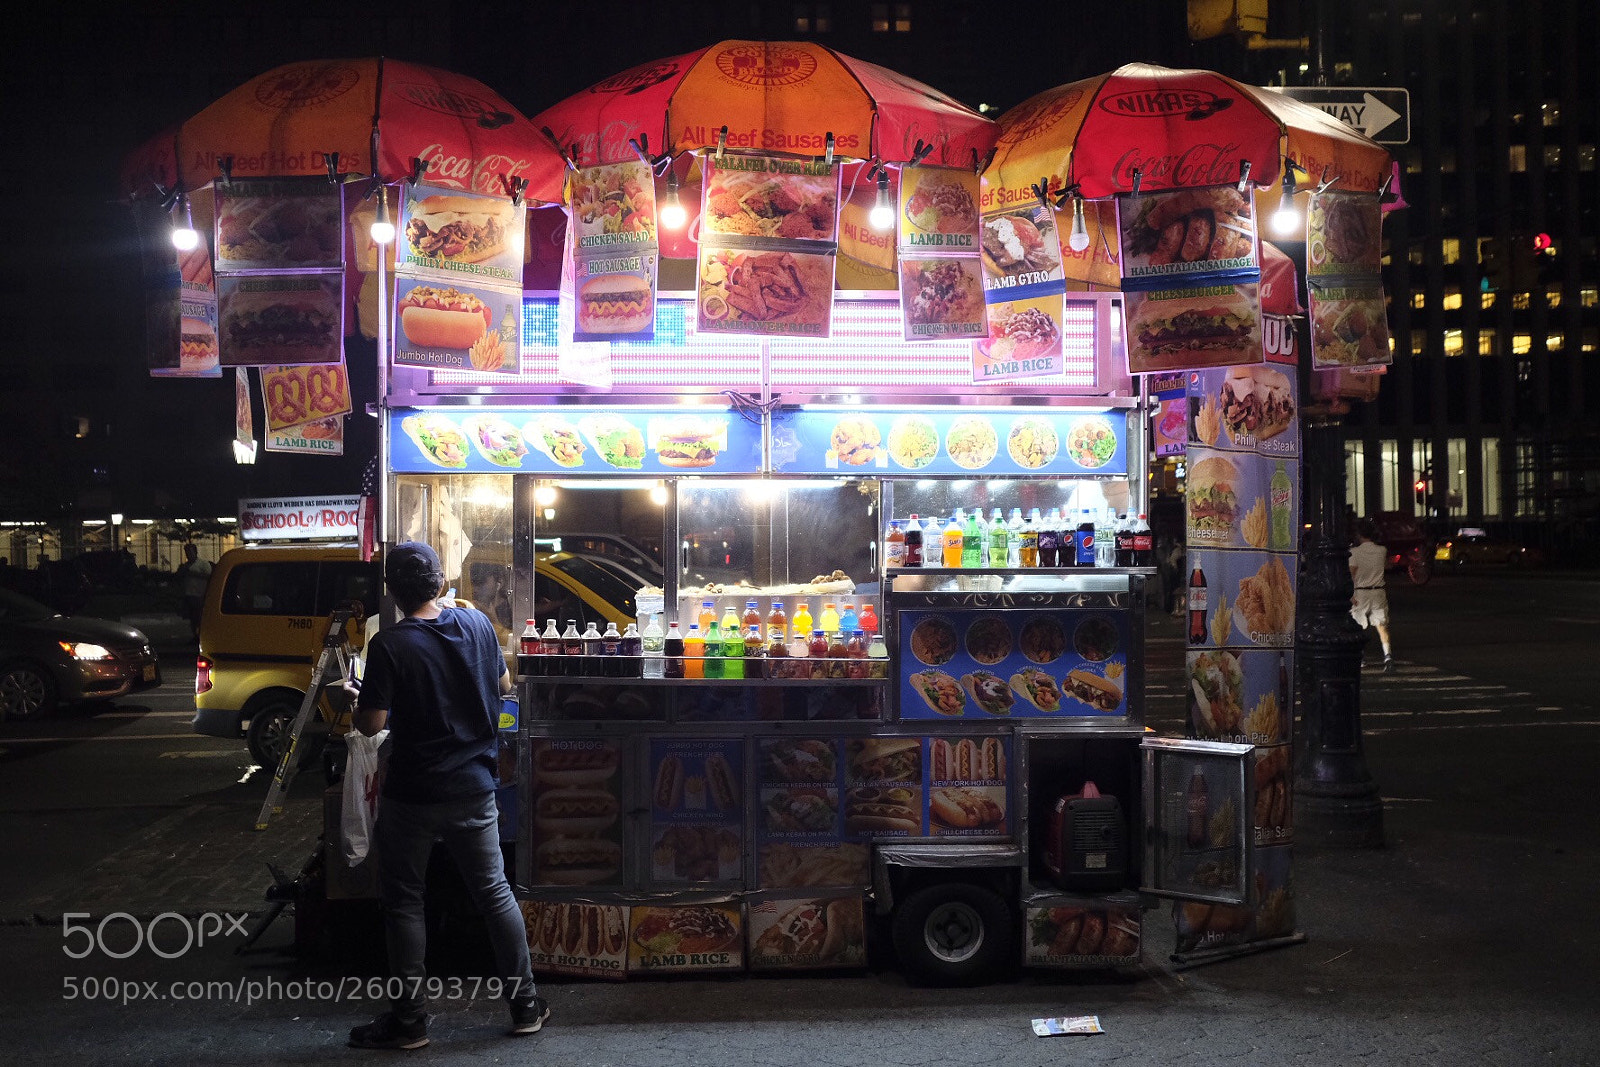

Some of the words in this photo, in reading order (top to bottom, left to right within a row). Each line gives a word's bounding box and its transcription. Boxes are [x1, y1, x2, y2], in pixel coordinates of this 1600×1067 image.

[1117, 93, 1200, 113] NIKAS
[681, 126, 705, 144] All
[761, 128, 859, 149] Sausaes
[272, 151, 306, 170] Hot
[311, 151, 360, 173] Dgs
[416, 143, 532, 193] Coca-Col
[1111, 143, 1241, 189] Coca-Cola
[997, 179, 1062, 205] Sausaes
[580, 233, 618, 248] CHICKEN
[619, 231, 650, 243] SALAD
[910, 233, 943, 246] LAMB
[945, 233, 972, 246] RICE
[407, 255, 442, 270] PHILLY
[443, 260, 481, 275] CHEESE
[482, 266, 514, 279] STEAK
[589, 260, 604, 274] HOT
[605, 256, 640, 273] SAUSAGE
[1131, 264, 1163, 277] HALAL
[1163, 260, 1206, 275] ITALIAN
[1207, 257, 1253, 271] SAUSAGE
[986, 276, 1017, 290] LAMB
[1018, 270, 1050, 287] GYRO
[181, 304, 206, 317] AUSAGE
[706, 318, 744, 330] LAMB
[745, 319, 787, 332] OVER
[789, 322, 822, 334] RICE
[912, 323, 949, 335] CHICKEN
[963, 323, 982, 333] RICE
[396, 349, 426, 362] Jumbo
[428, 352, 444, 364] Hot
[445, 353, 463, 366] Dog
[983, 361, 1020, 376] LAMB
[1022, 357, 1053, 372] RICE
[276, 436, 308, 448] LAMB
[309, 438, 335, 450] RICE
[1165, 443, 1186, 453] LAM
[1235, 433, 1257, 449] Philly
[1272, 439, 1296, 452] Steak
[315, 499, 344, 507] BROADWAY
[242, 510, 308, 531] SCHOOL
[306, 512, 320, 527] of
[321, 509, 359, 528] ROC
[551, 740, 575, 751] HOT
[578, 740, 603, 751] DOG
[1251, 732, 1270, 744] Pita
[530, 953, 555, 963] EST
[557, 955, 587, 966] HOT
[590, 958, 620, 970] DOG
[639, 954, 687, 967] LAMB
[690, 953, 730, 965] RICE
